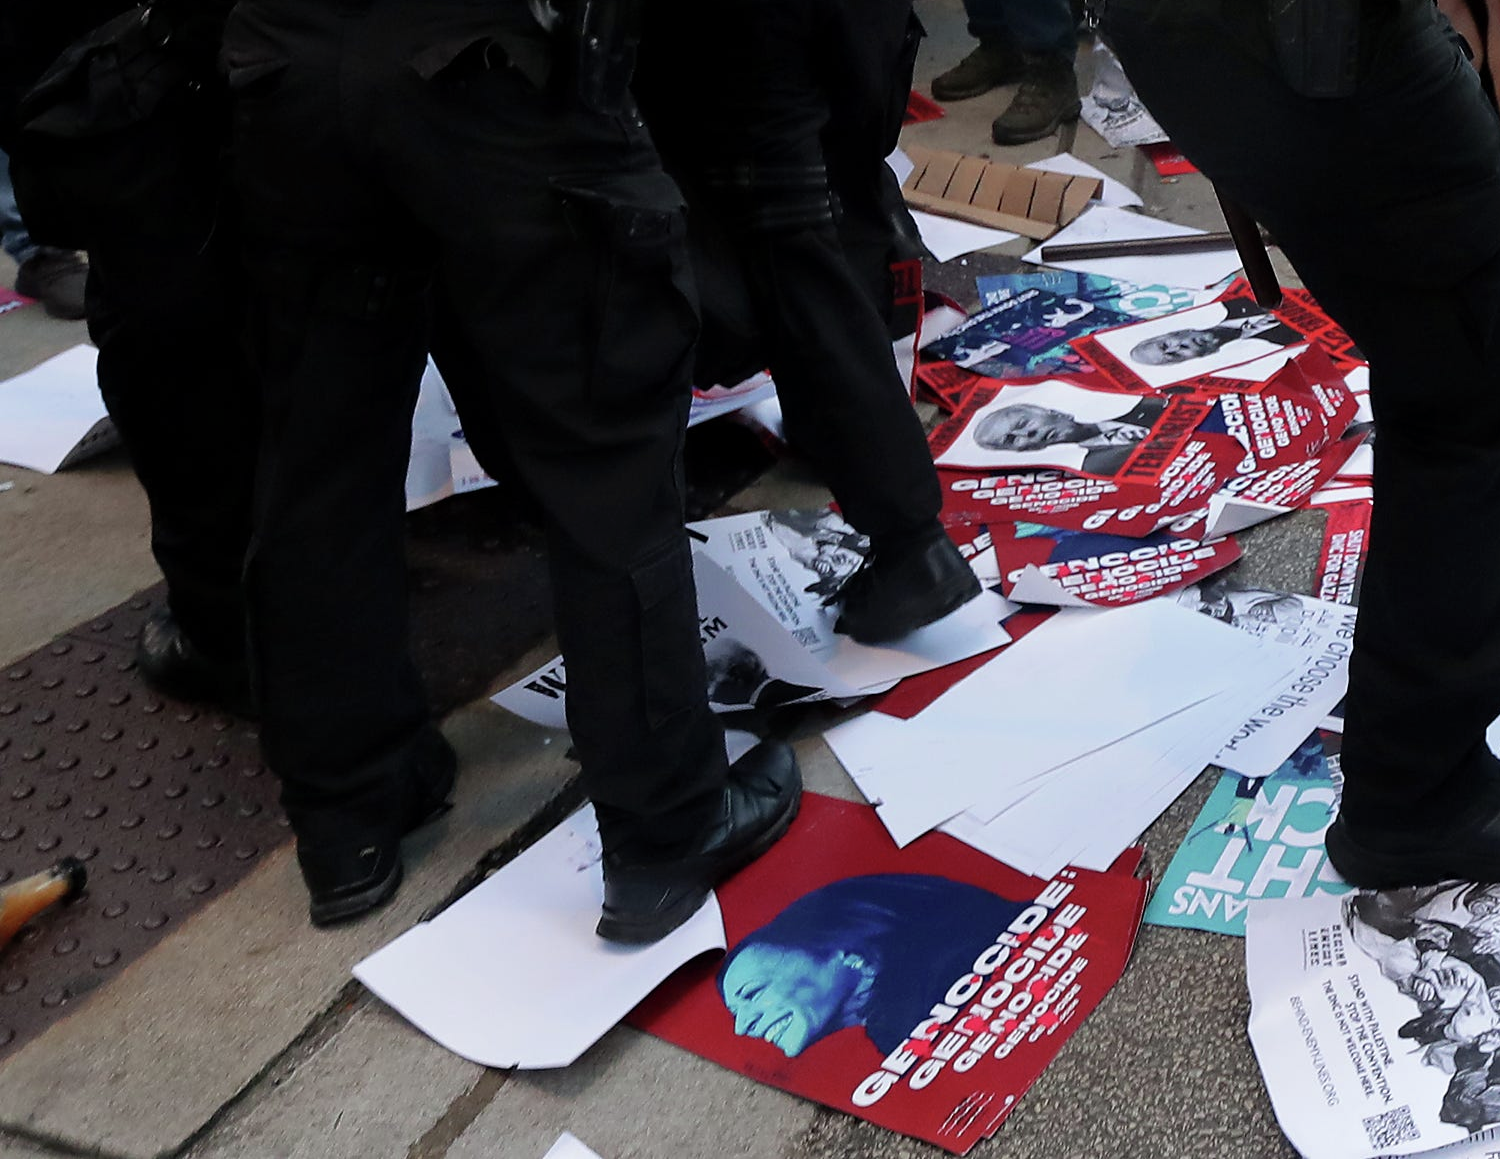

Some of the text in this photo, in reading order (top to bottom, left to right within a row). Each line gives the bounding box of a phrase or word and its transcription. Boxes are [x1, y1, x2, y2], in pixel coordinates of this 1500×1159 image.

[1122, 396, 1211, 479] TERRORIST
[1290, 640, 1350, 695] choose
[1261, 693, 1309, 718] the
[908, 902, 1088, 1091] GENOCIDE
[993, 955, 1089, 1060] GENOCIDE
[1322, 977, 1334, 995] THE
[1327, 992, 1342, 1013] DNC
[1348, 973, 1366, 1002] STAND
[1360, 998, 1376, 1022] WITH
[1337, 1017, 1353, 1038] NOT
[1344, 1000, 1395, 1107] STOP THE CONVENTION
[1344, 1033, 1367, 1076] WELCOME
